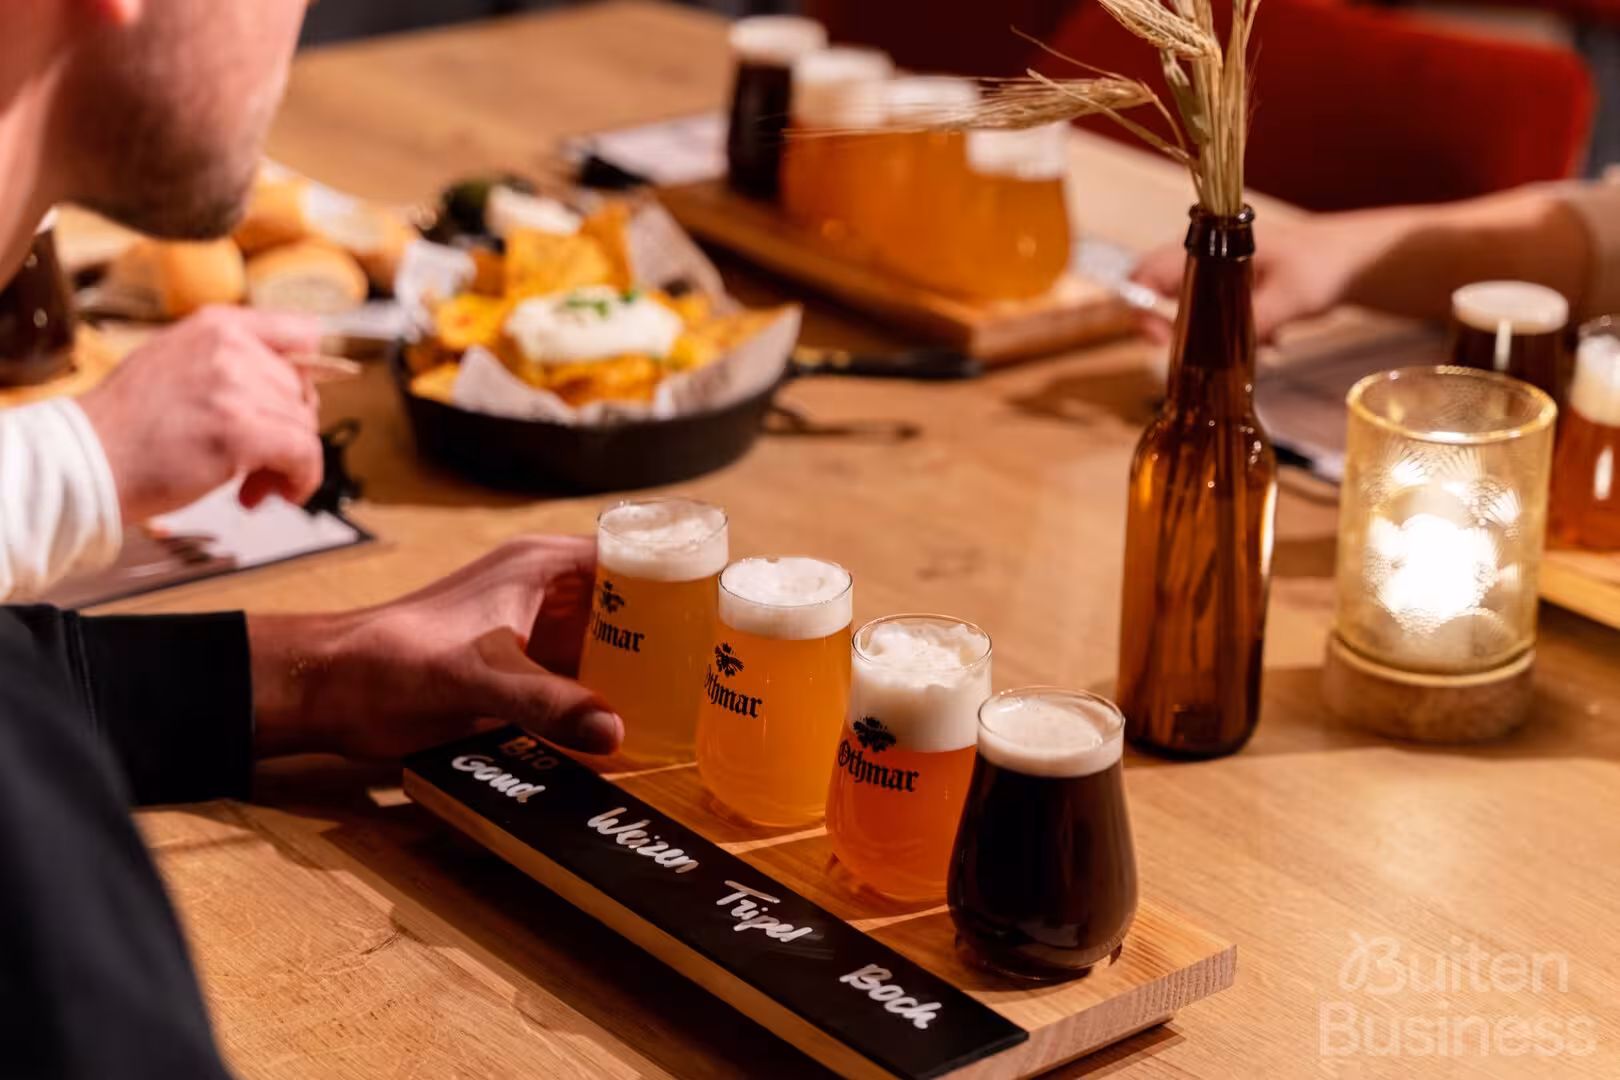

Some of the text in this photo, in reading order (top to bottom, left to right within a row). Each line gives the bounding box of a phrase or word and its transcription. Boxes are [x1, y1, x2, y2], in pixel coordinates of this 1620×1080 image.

[451, 754, 547, 804] Goud
[837, 740, 919, 793] Othmar
[587, 806, 700, 874] Weizen
[715, 879, 813, 943] Tripel
[838, 963, 943, 1030] Bock
